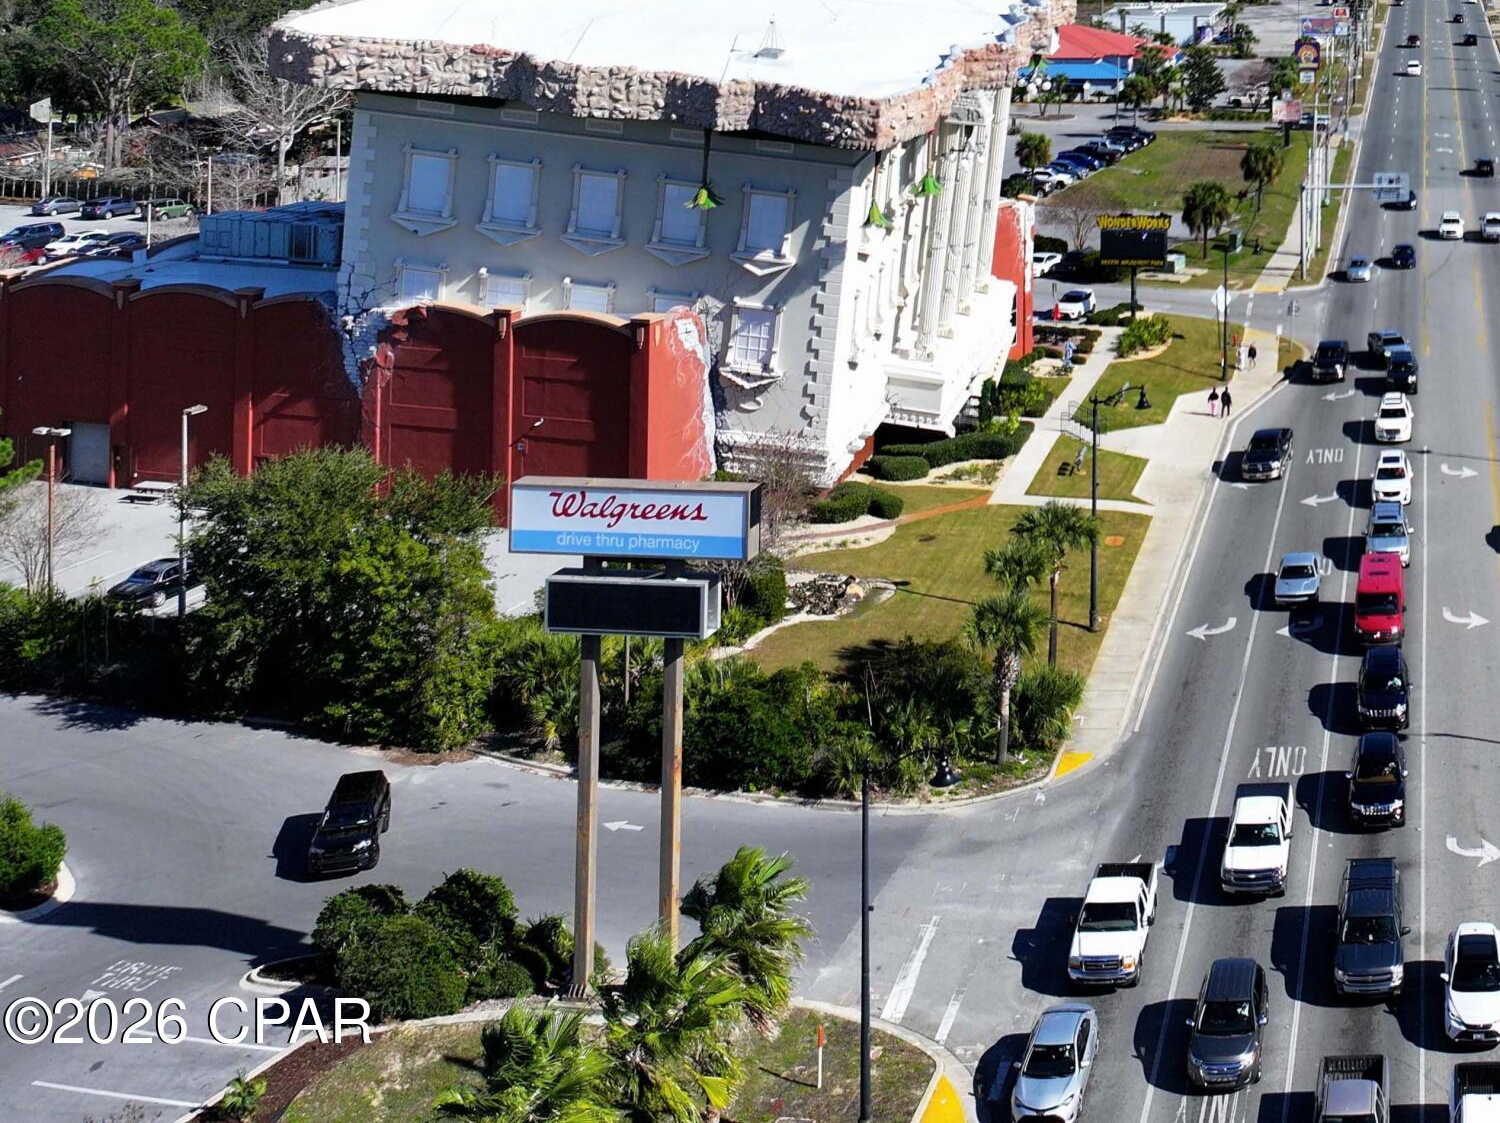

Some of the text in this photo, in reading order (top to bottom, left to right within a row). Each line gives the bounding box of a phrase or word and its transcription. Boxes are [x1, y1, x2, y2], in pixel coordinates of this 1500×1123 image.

[1306, 447, 1344, 465] ONLY
[549, 490, 708, 528] Walgreens
[556, 532, 700, 553] drive thru pharmacy
[1248, 746, 1307, 778] ONLY
[106, 960, 183, 979] DRIVE
[91, 972, 158, 992] THRU
